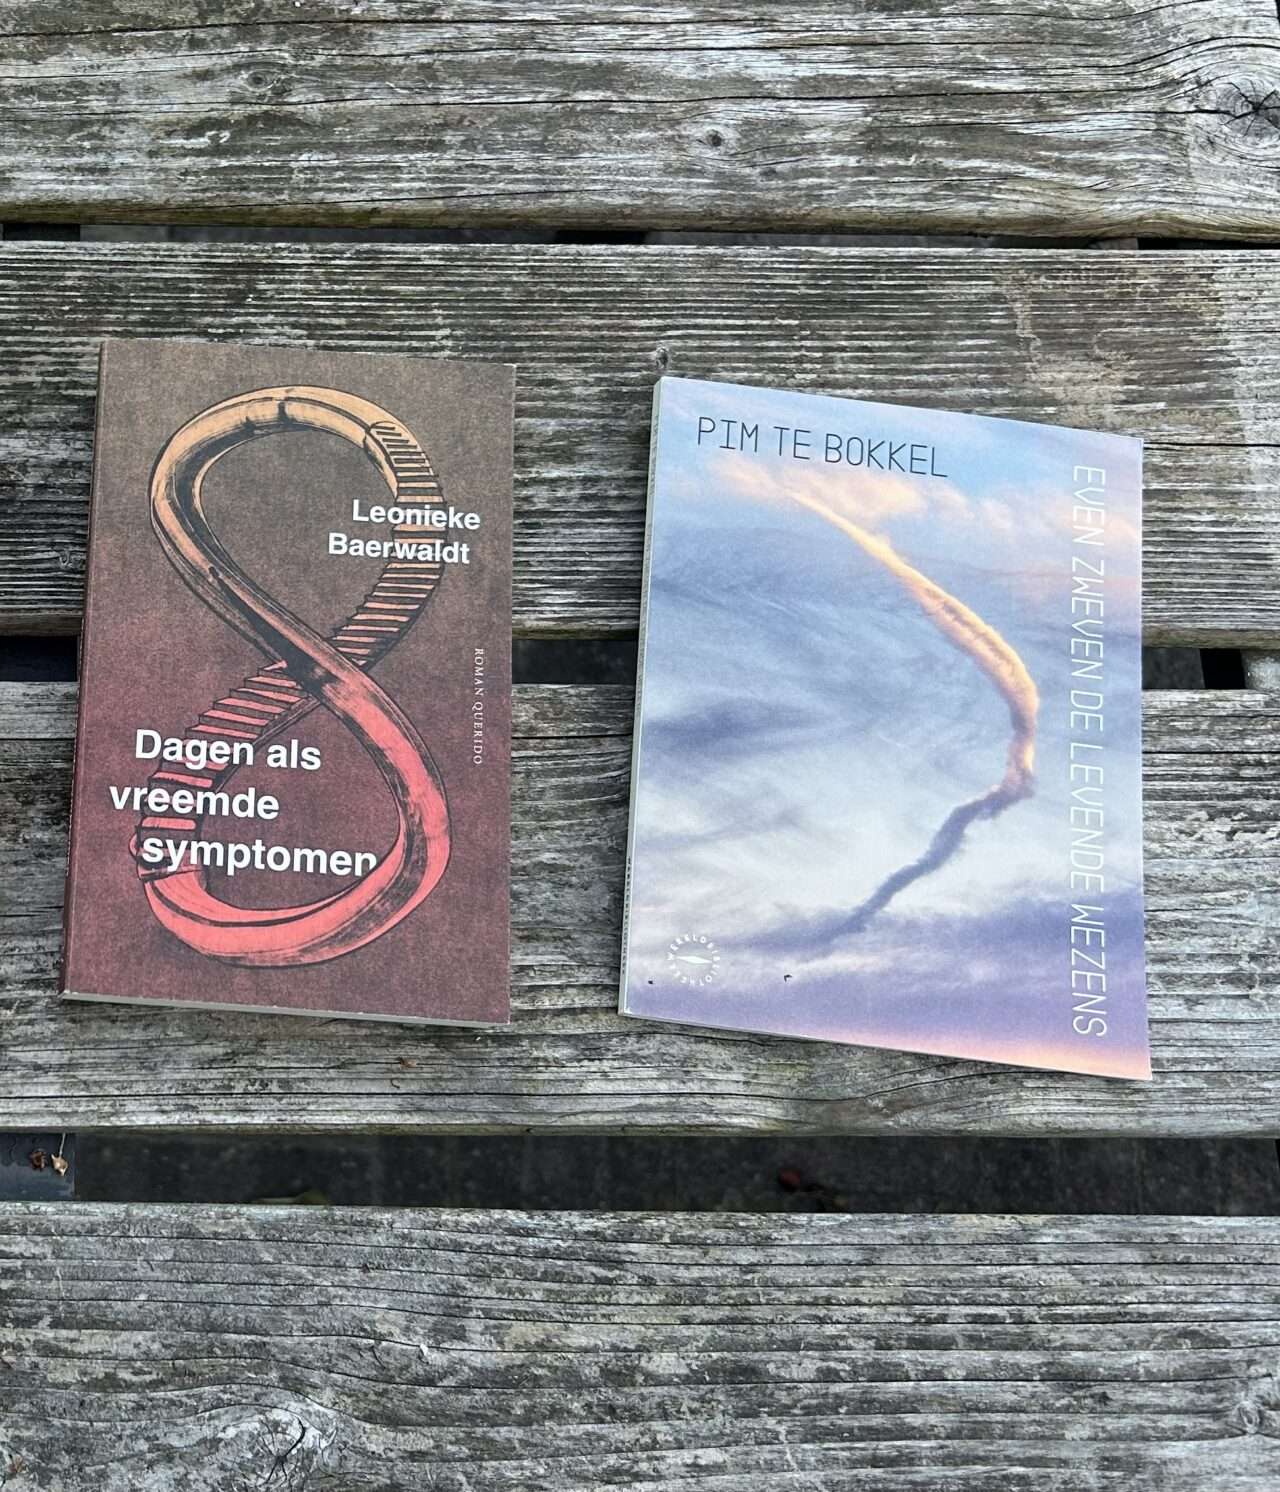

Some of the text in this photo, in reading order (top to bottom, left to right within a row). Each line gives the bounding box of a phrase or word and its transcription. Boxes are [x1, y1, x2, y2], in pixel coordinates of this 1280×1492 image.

[697, 416, 949, 478] PIM TE BOKKEL
[352, 498, 481, 530] Leonieke
[328, 532, 471, 564] Baerwaldt
[471, 647, 485, 765] ROMAN QUERIDO
[135, 728, 322, 770] Dagen als
[1069, 464, 1108, 1038] EVEN ZWEVEN DE LEVENDE WEZENS
[109, 785, 280, 820] vreemde
[141, 836, 378, 877] symptomen
